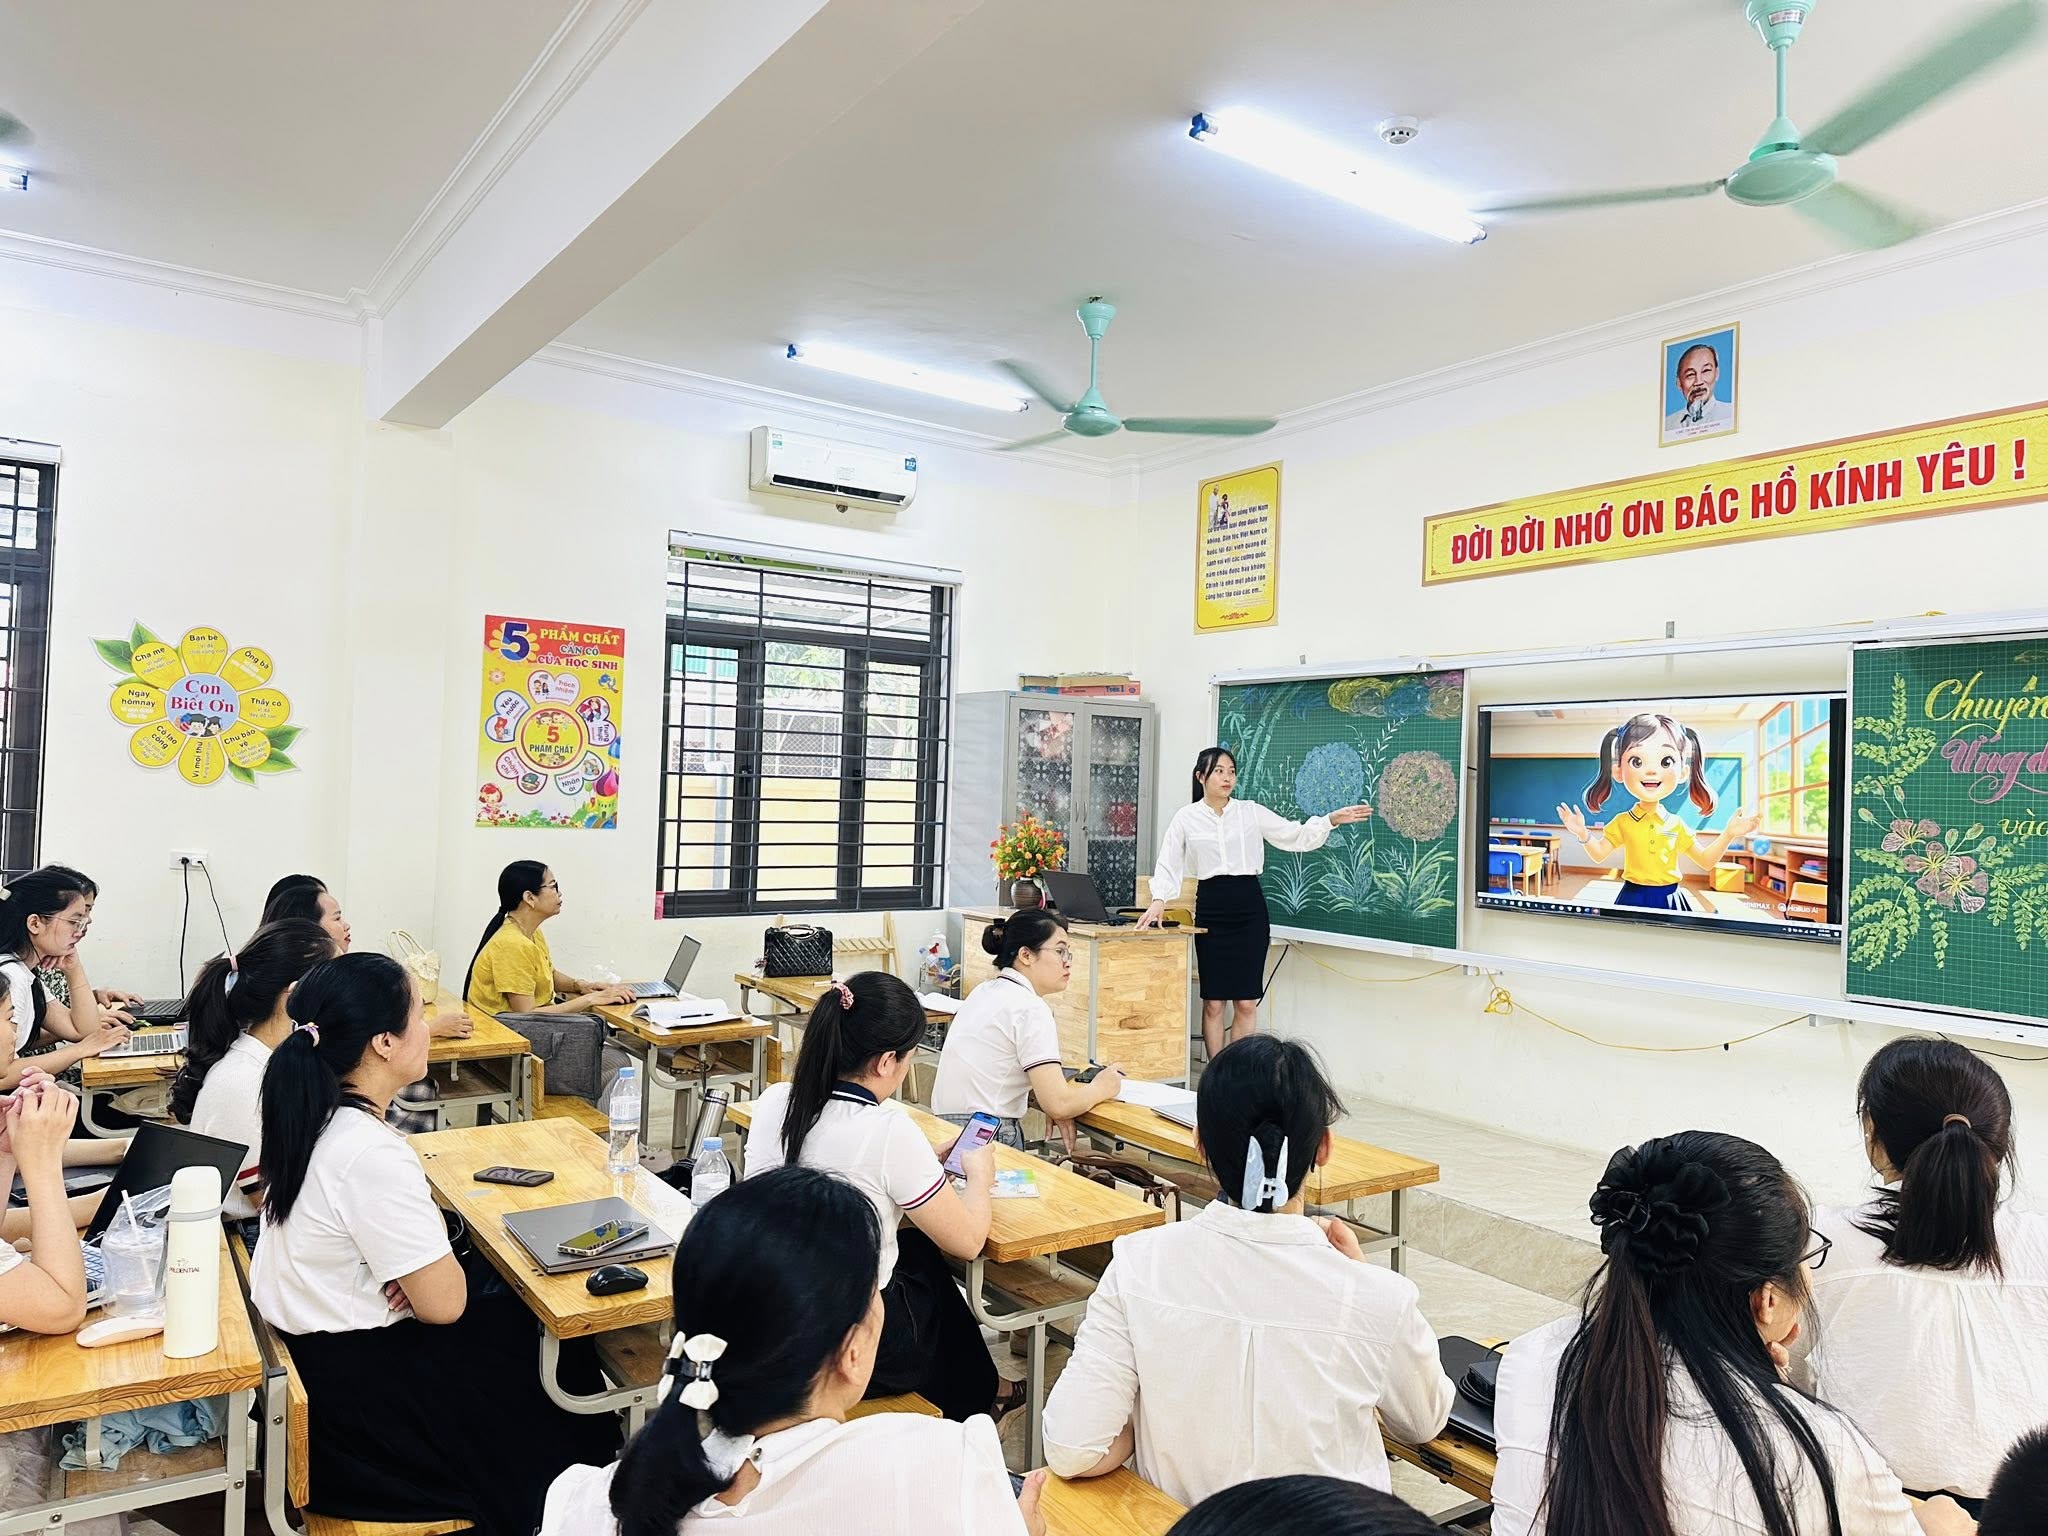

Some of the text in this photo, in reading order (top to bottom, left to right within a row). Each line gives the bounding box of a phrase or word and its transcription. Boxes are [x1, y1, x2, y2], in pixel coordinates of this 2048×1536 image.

[1451, 439, 2025, 564] ĐỜI ĐỜI NHỚ ƠN BÁC HỒ KÍNH YÊU !
[500, 621, 530, 662] 5
[540, 624, 620, 645] PHẨM CHẤT
[537, 652, 619, 671] CỦA HỌC SINH
[185, 679, 221, 695] Con
[171, 693, 235, 713] Biết Ơn
[546, 726, 561, 743] 5
